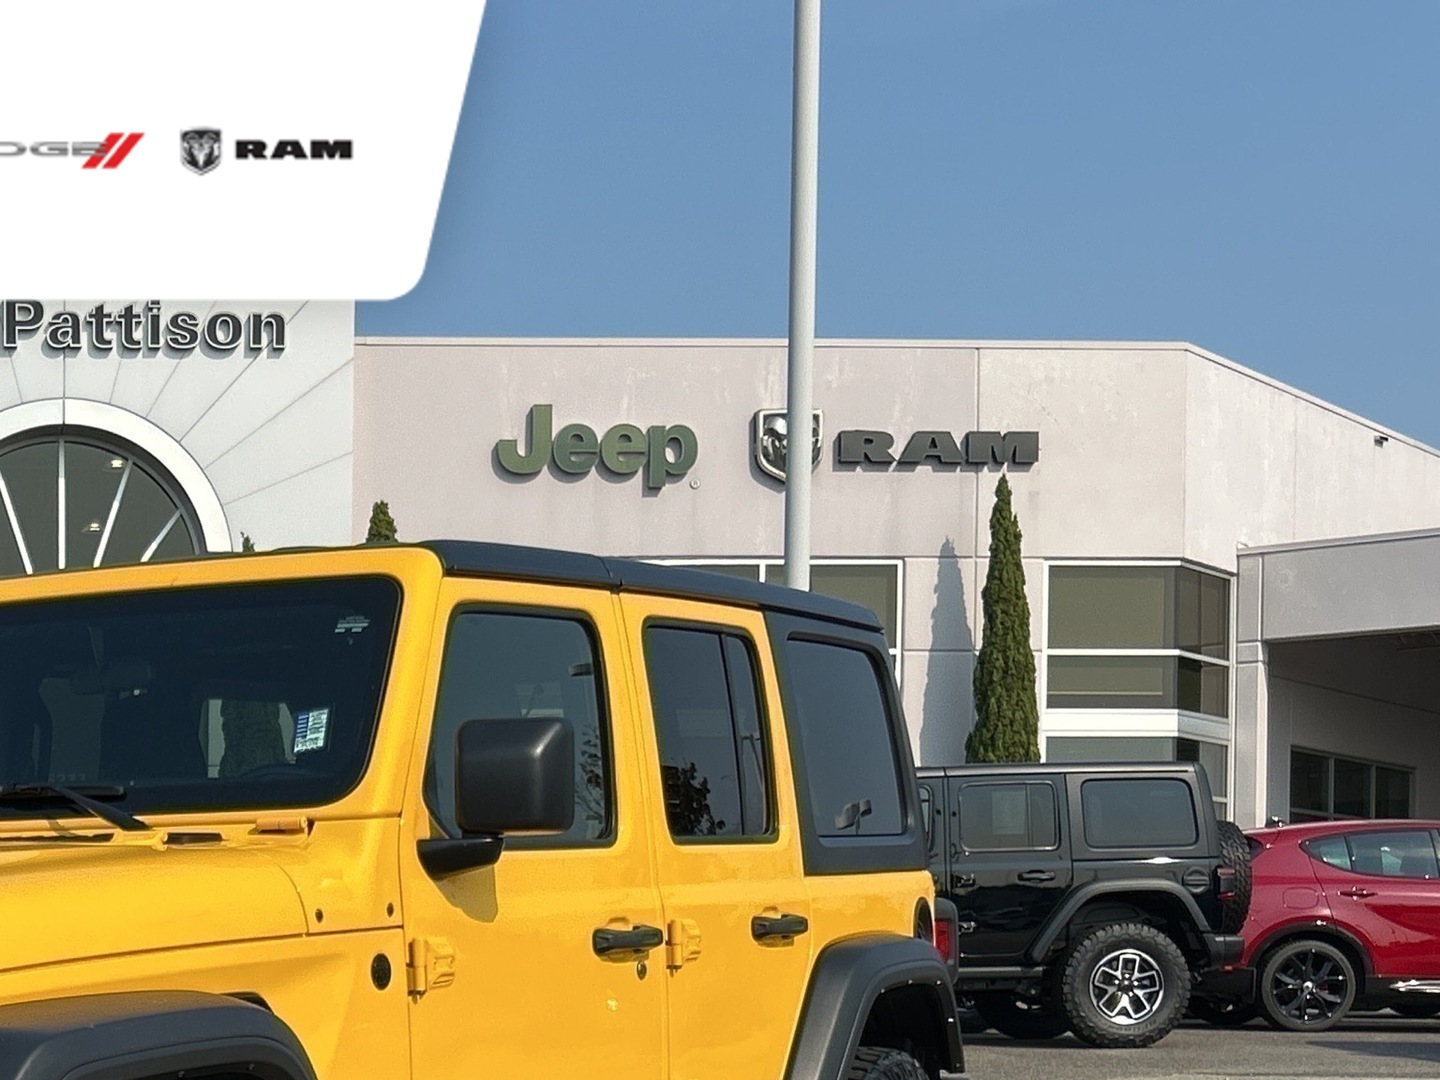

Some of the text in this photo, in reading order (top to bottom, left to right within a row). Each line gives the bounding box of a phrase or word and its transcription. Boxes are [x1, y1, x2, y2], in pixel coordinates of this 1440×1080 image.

[1, 301, 288, 351] Pattison
[495, 404, 698, 488] Jeep
[837, 430, 1040, 465] RAM
